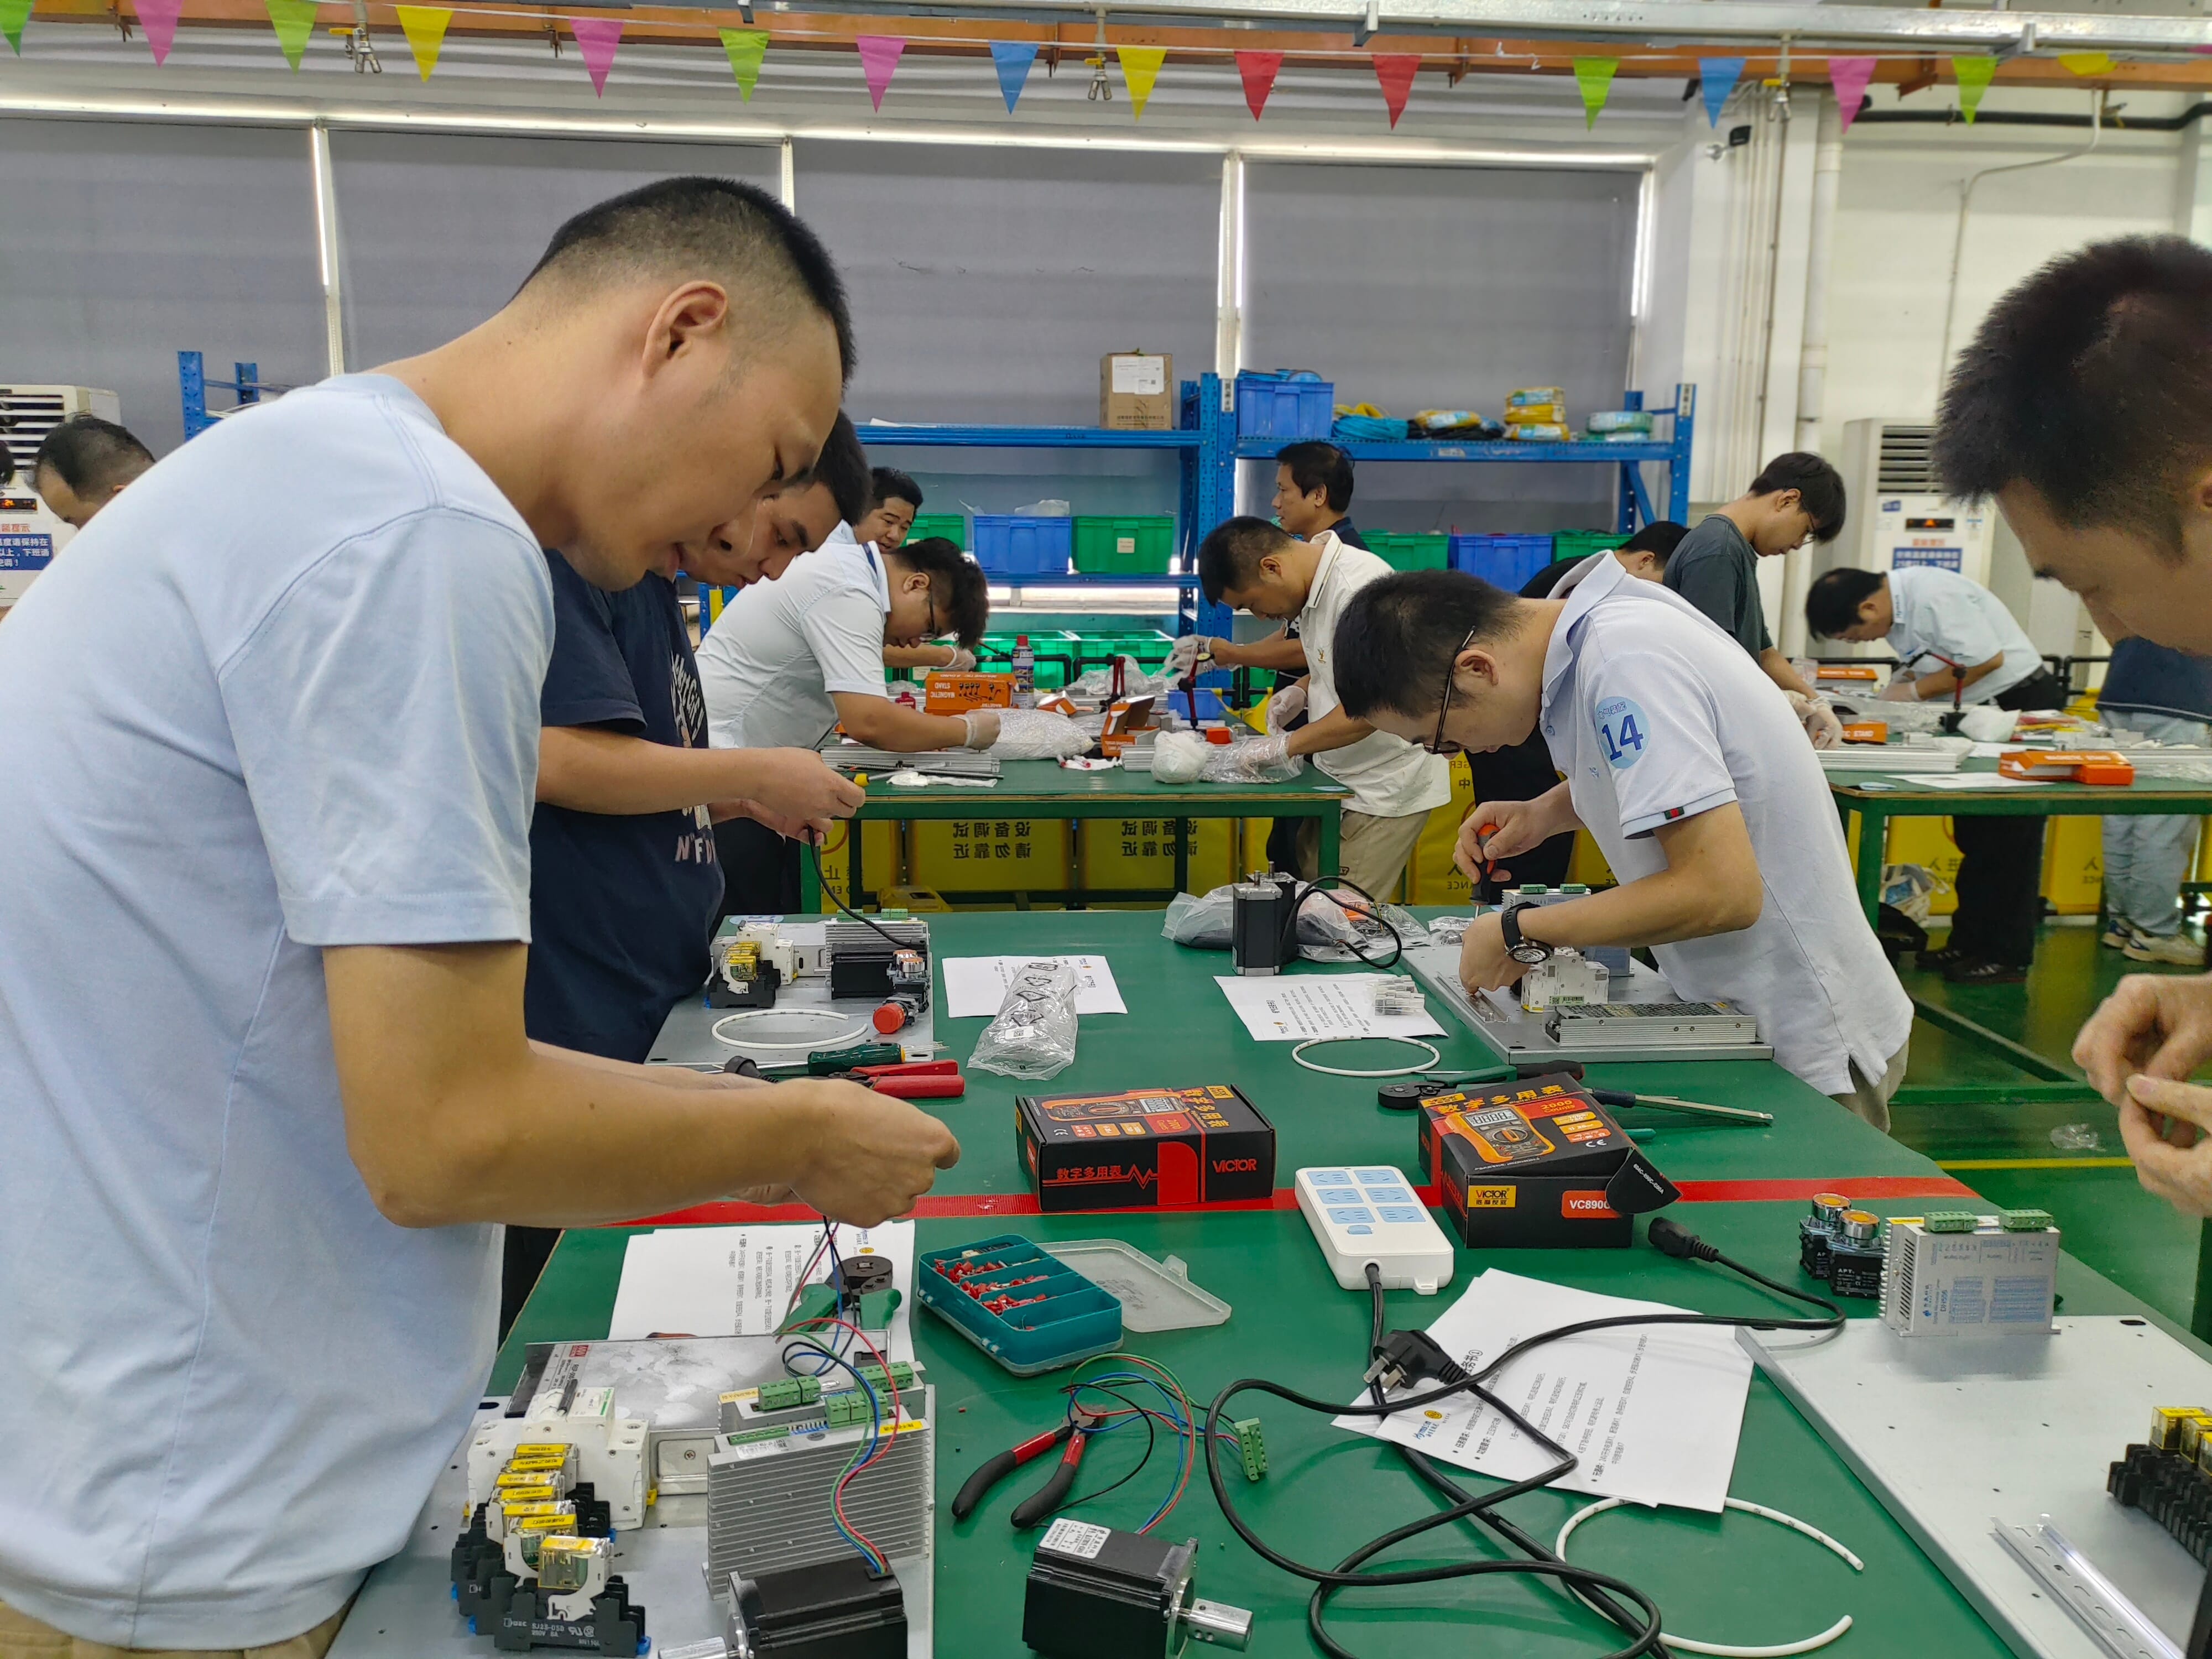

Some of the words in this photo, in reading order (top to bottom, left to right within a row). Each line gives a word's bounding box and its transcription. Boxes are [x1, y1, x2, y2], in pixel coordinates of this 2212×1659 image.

[1601, 714, 1644, 761] 14
[1056, 1165, 1121, 1181] 数字多用表
[1213, 1159, 1257, 1173] VICTOR
[1476, 1190, 1507, 1198] VICTOR
